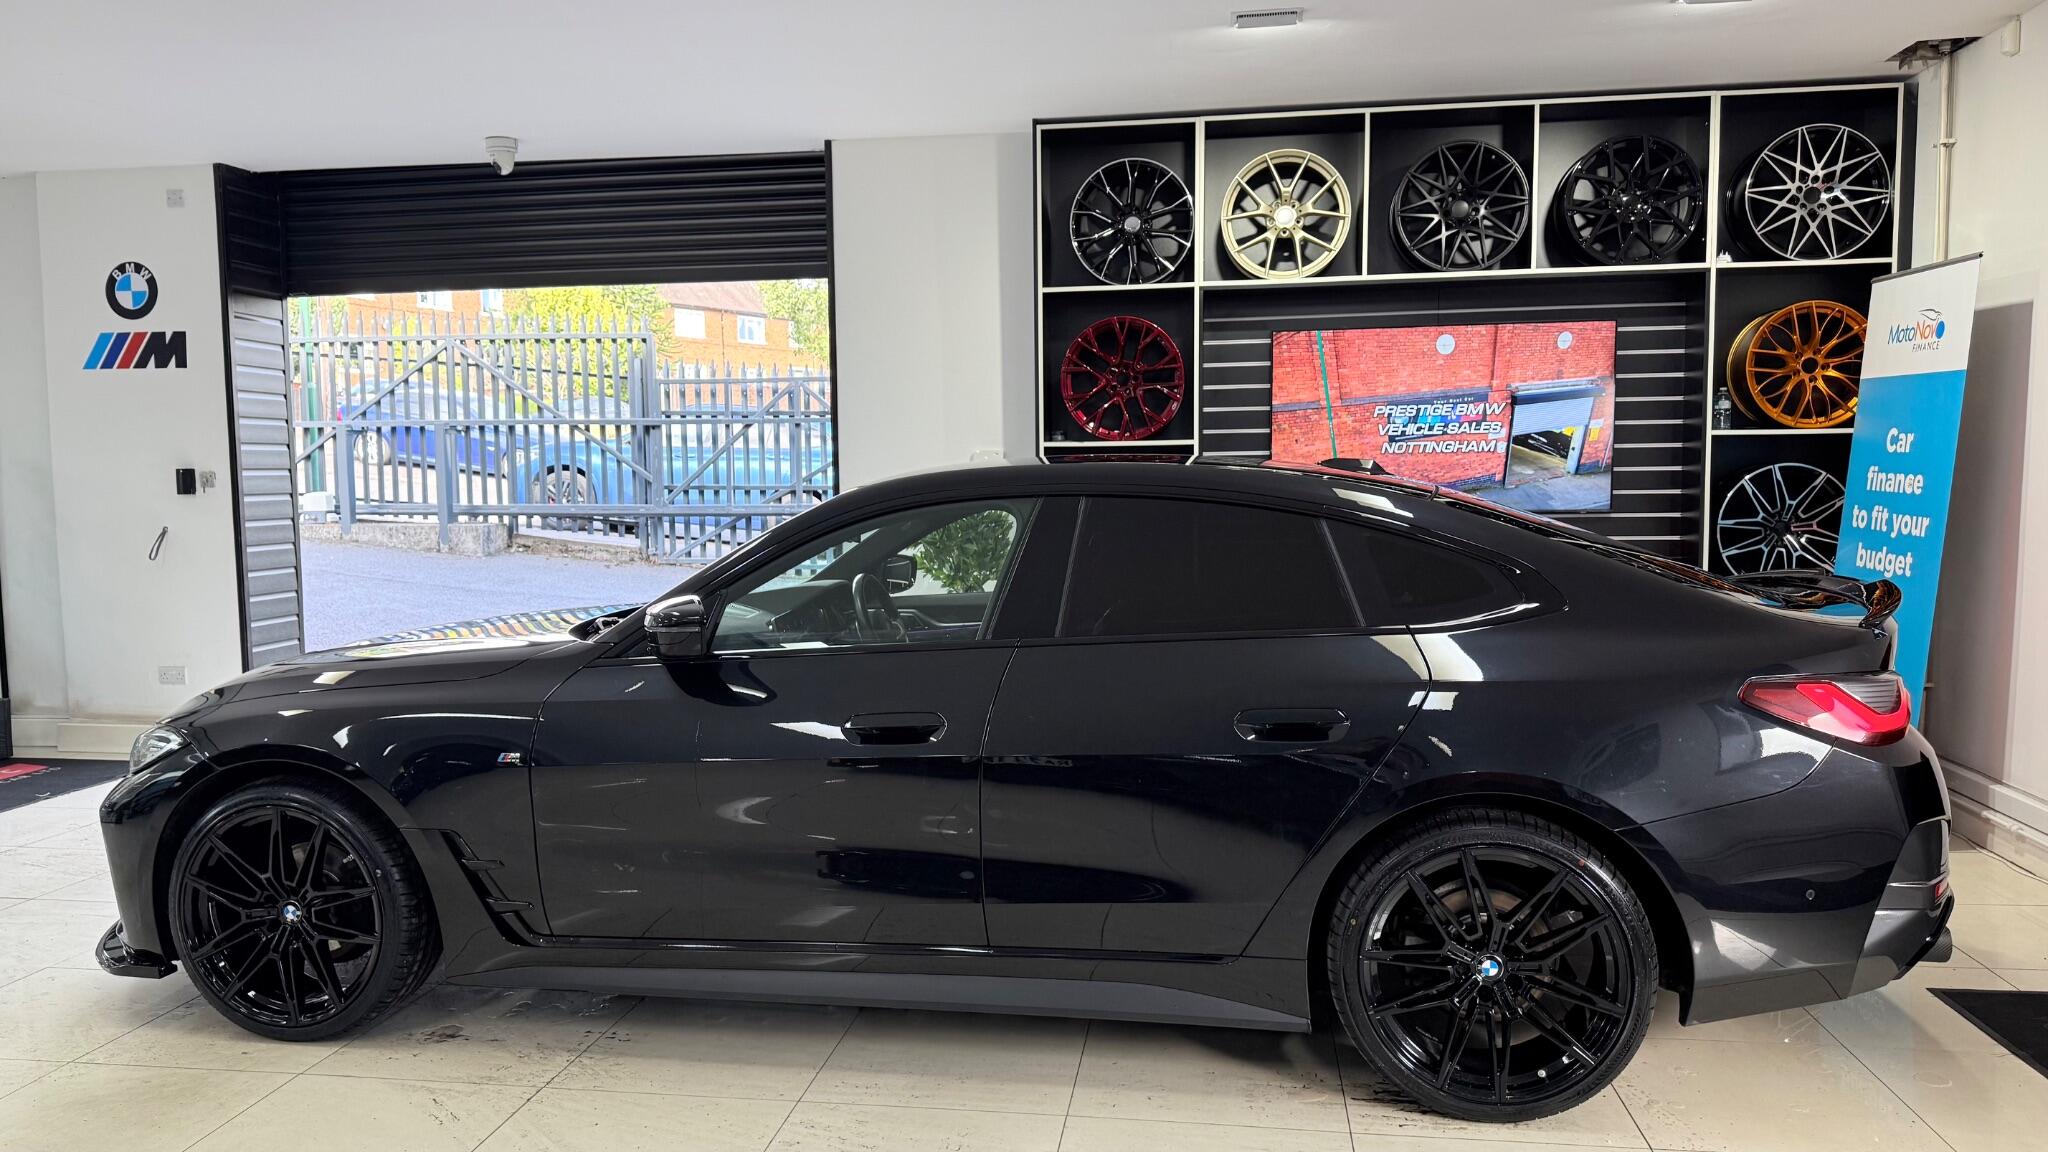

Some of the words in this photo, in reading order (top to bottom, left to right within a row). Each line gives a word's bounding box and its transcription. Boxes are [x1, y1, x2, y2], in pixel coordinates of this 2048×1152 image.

[112, 263, 152, 280] BMW
[1912, 340, 1941, 352] FINANCE
[1373, 404, 1454, 418] PRESTIGE
[1455, 402, 1507, 416] BMW
[1378, 422, 1444, 436] VEHICLE
[1446, 421, 1502, 434] SALES
[1381, 440, 1497, 454] NOTTINGHAM
[1886, 427, 1915, 453] Car
[1866, 465, 1924, 495] finance
[1852, 505, 1868, 529] to
[1871, 505, 1889, 532] fit
[1890, 513, 1930, 539] your
[1855, 542, 1912, 578] budget
